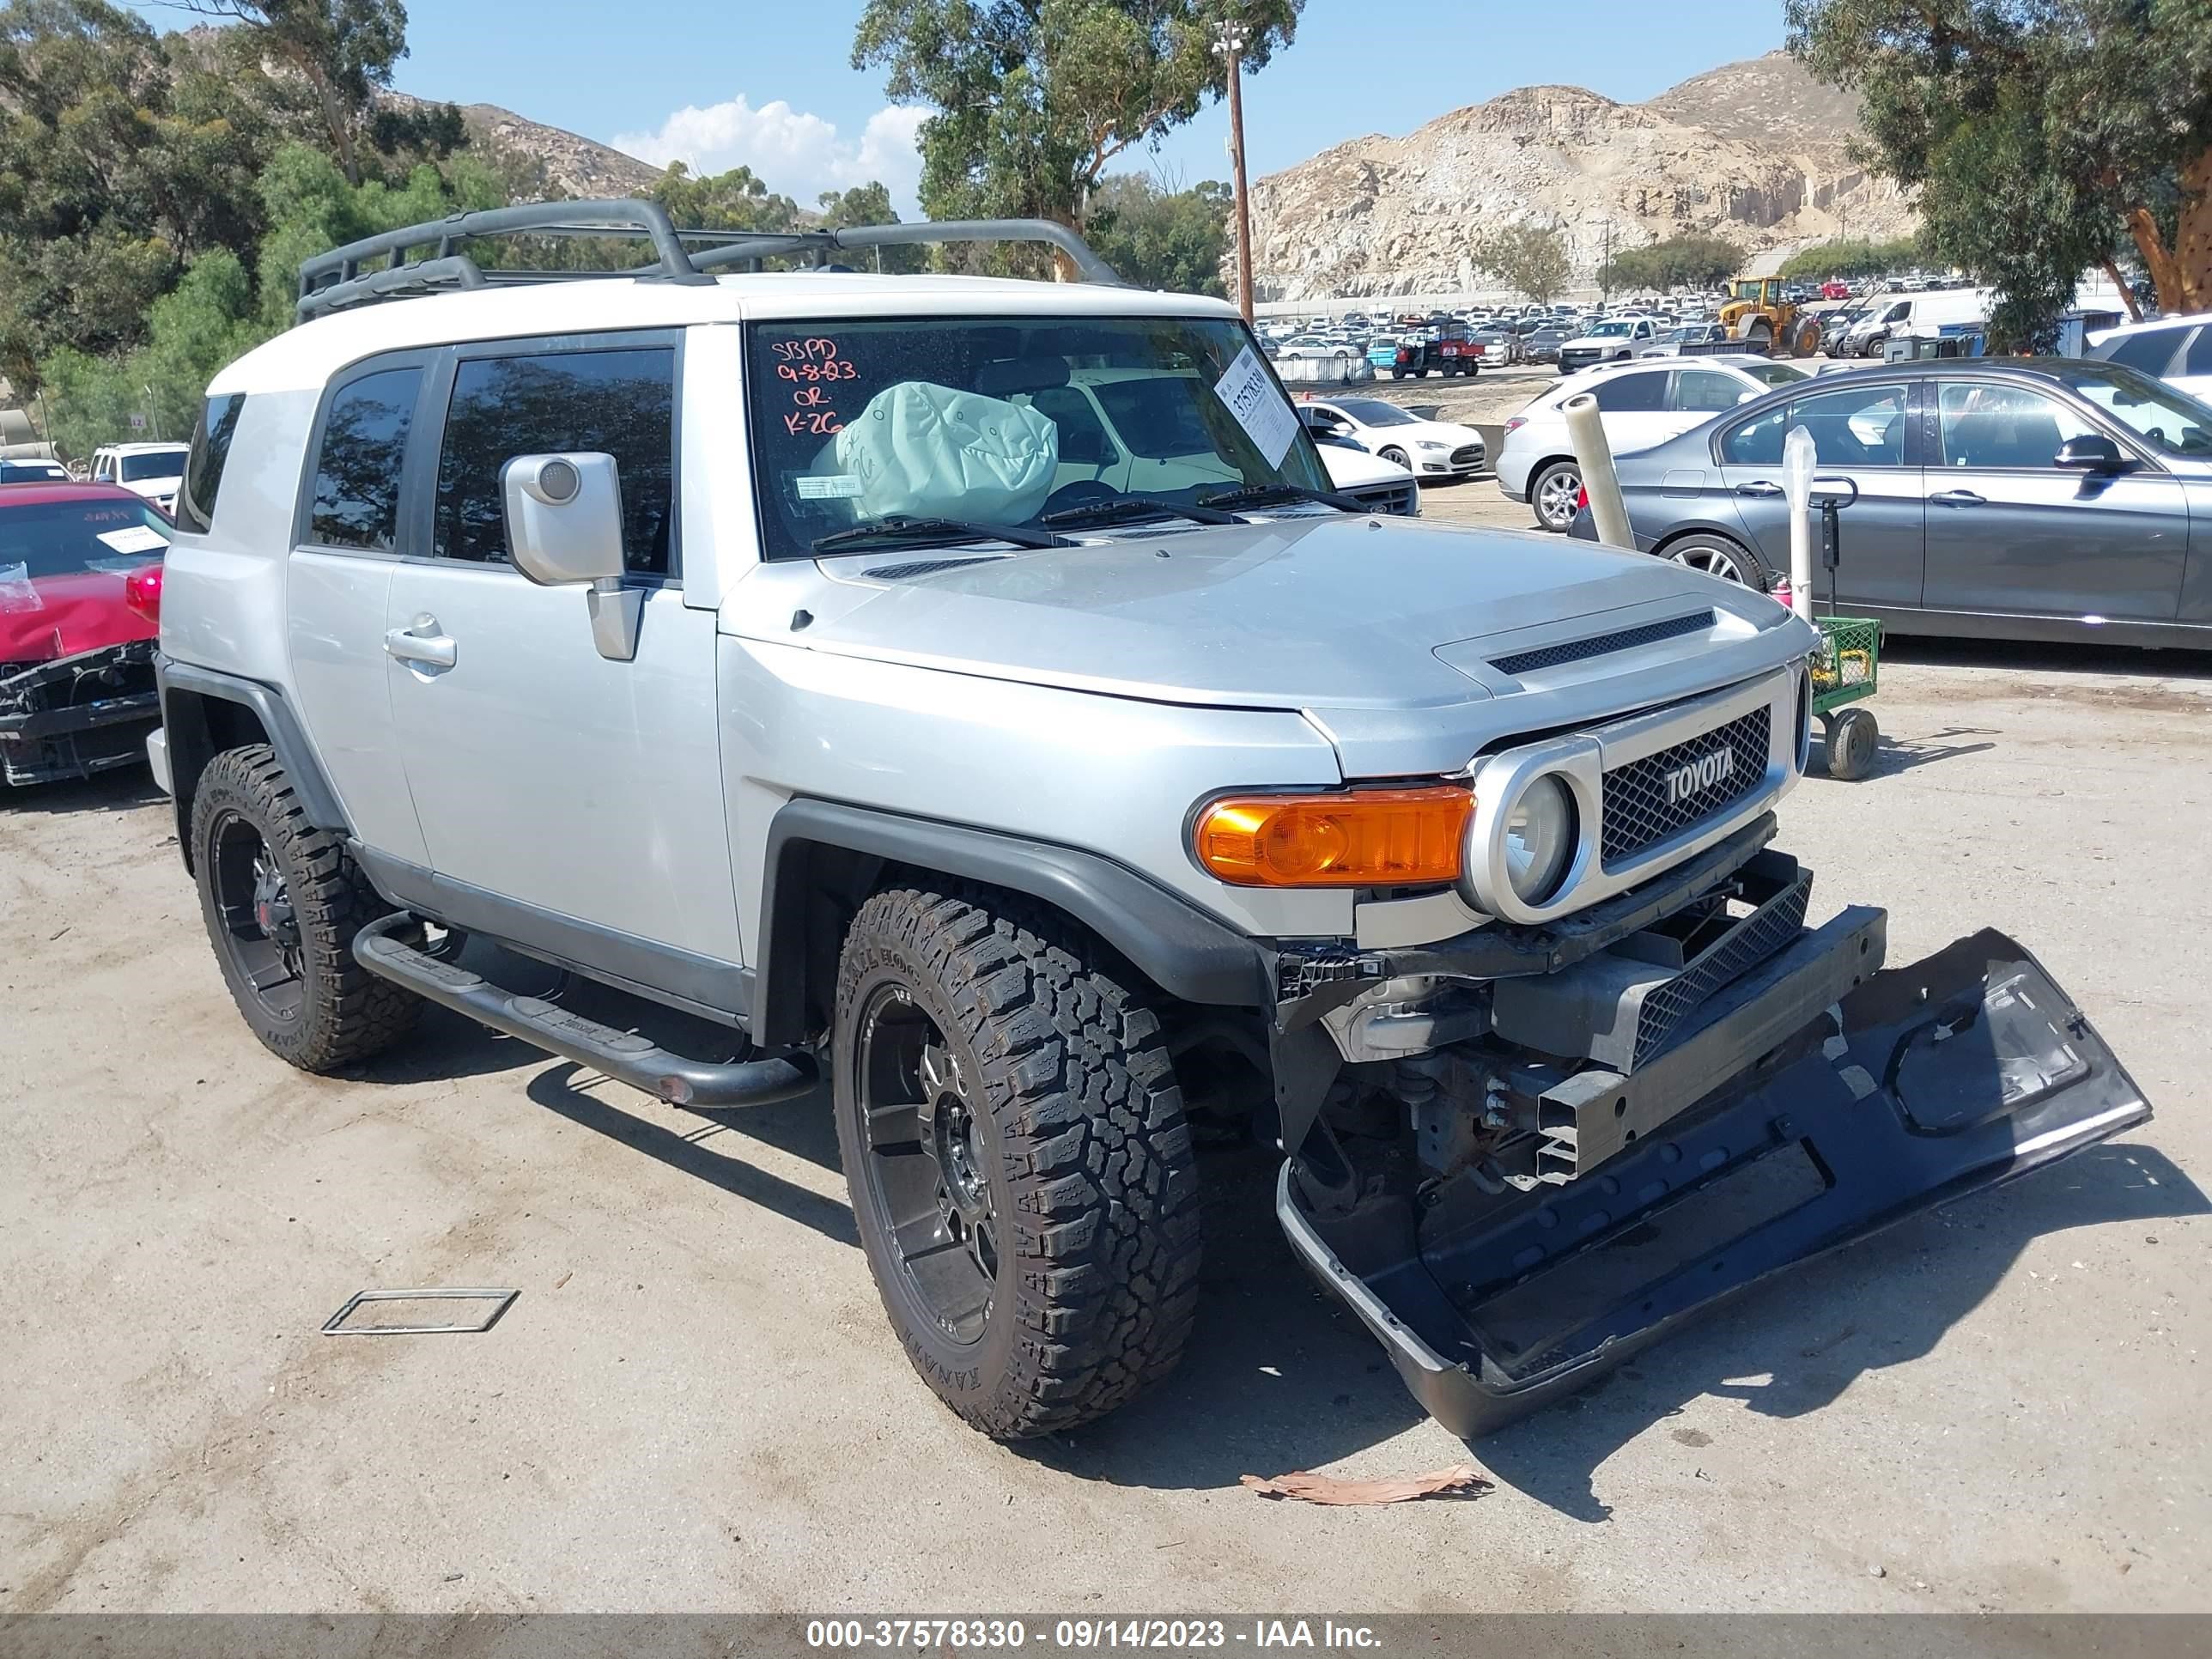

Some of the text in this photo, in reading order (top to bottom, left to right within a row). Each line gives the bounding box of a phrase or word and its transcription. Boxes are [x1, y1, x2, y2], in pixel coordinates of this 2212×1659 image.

[772, 338, 836, 361] SBPD
[1233, 368, 1266, 417] 37578330
[784, 411, 843, 435] K-26
[1665, 747, 1734, 805] TOYOTA
